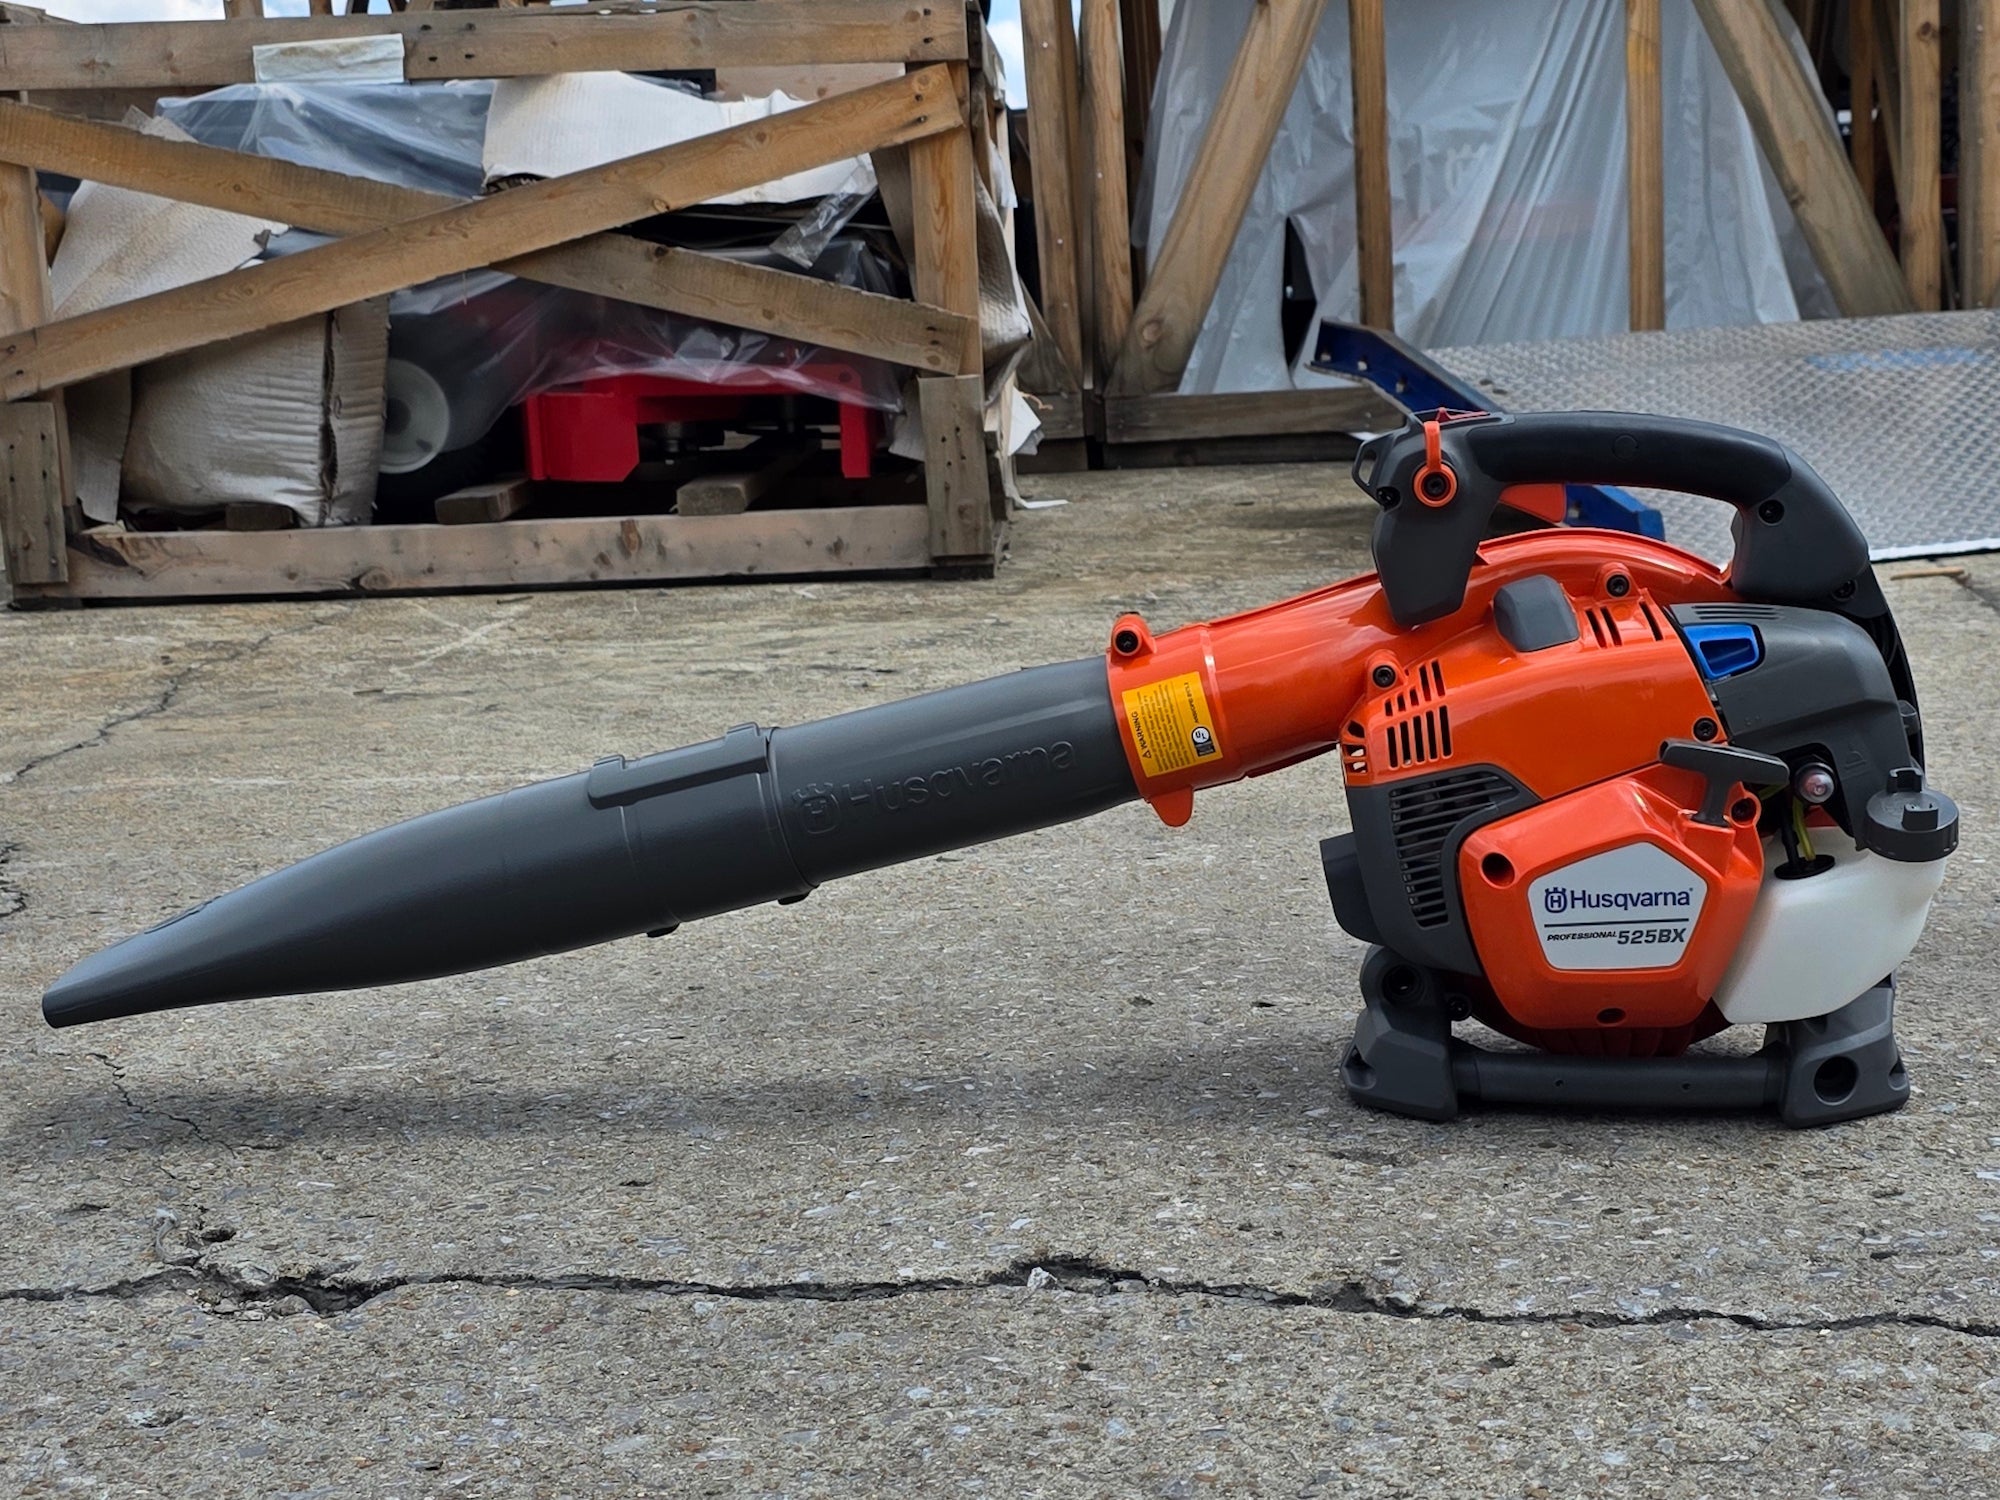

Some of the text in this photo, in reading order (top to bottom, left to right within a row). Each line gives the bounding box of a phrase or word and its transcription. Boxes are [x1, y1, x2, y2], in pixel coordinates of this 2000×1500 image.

[1131, 711, 1147, 750] WARNING
[841, 740, 1080, 818] Husqvarna
[1570, 889, 1690, 911] Husqvarna
[1546, 928, 1687, 945] PROFESSIONAL 525BX
